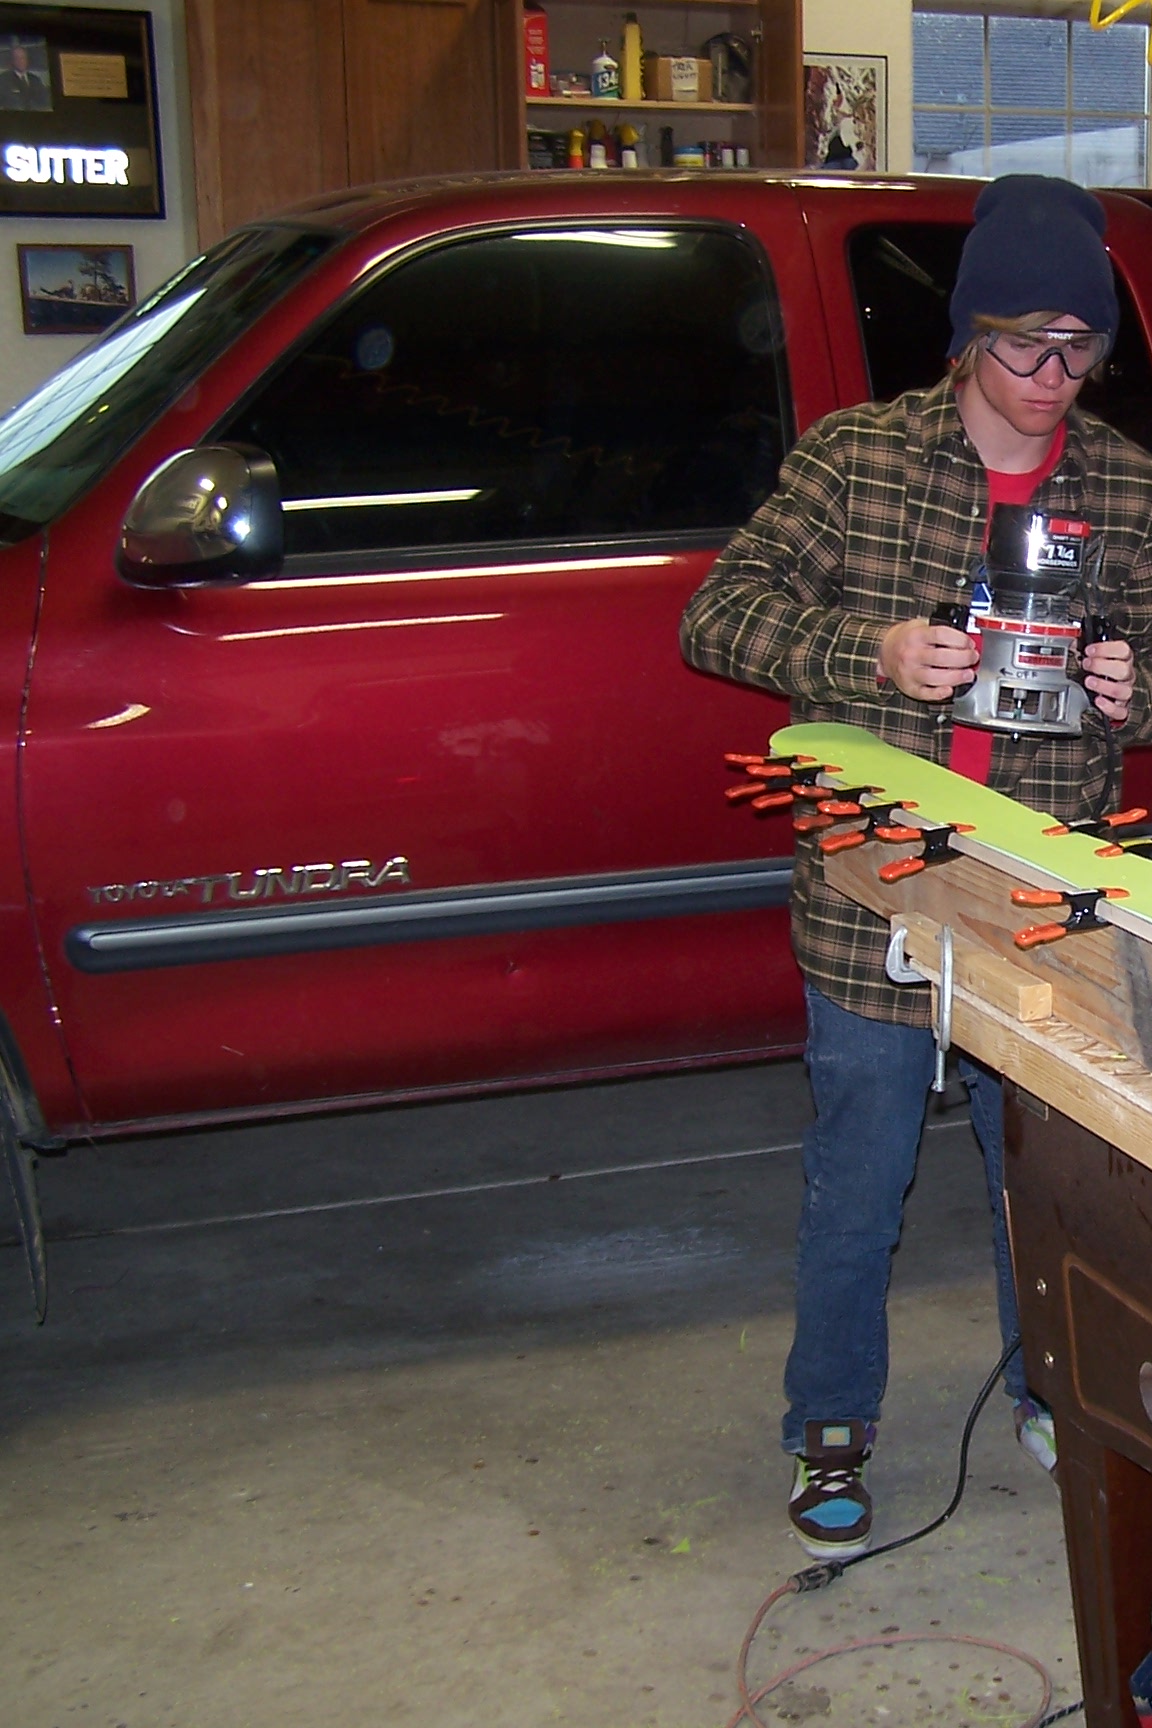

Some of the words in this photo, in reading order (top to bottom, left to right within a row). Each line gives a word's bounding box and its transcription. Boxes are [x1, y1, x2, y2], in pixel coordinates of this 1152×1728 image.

[5, 144, 130, 187] SUTTER
[86, 879, 189, 904] TOYOTA
[183, 855, 411, 903] TUNDRA
